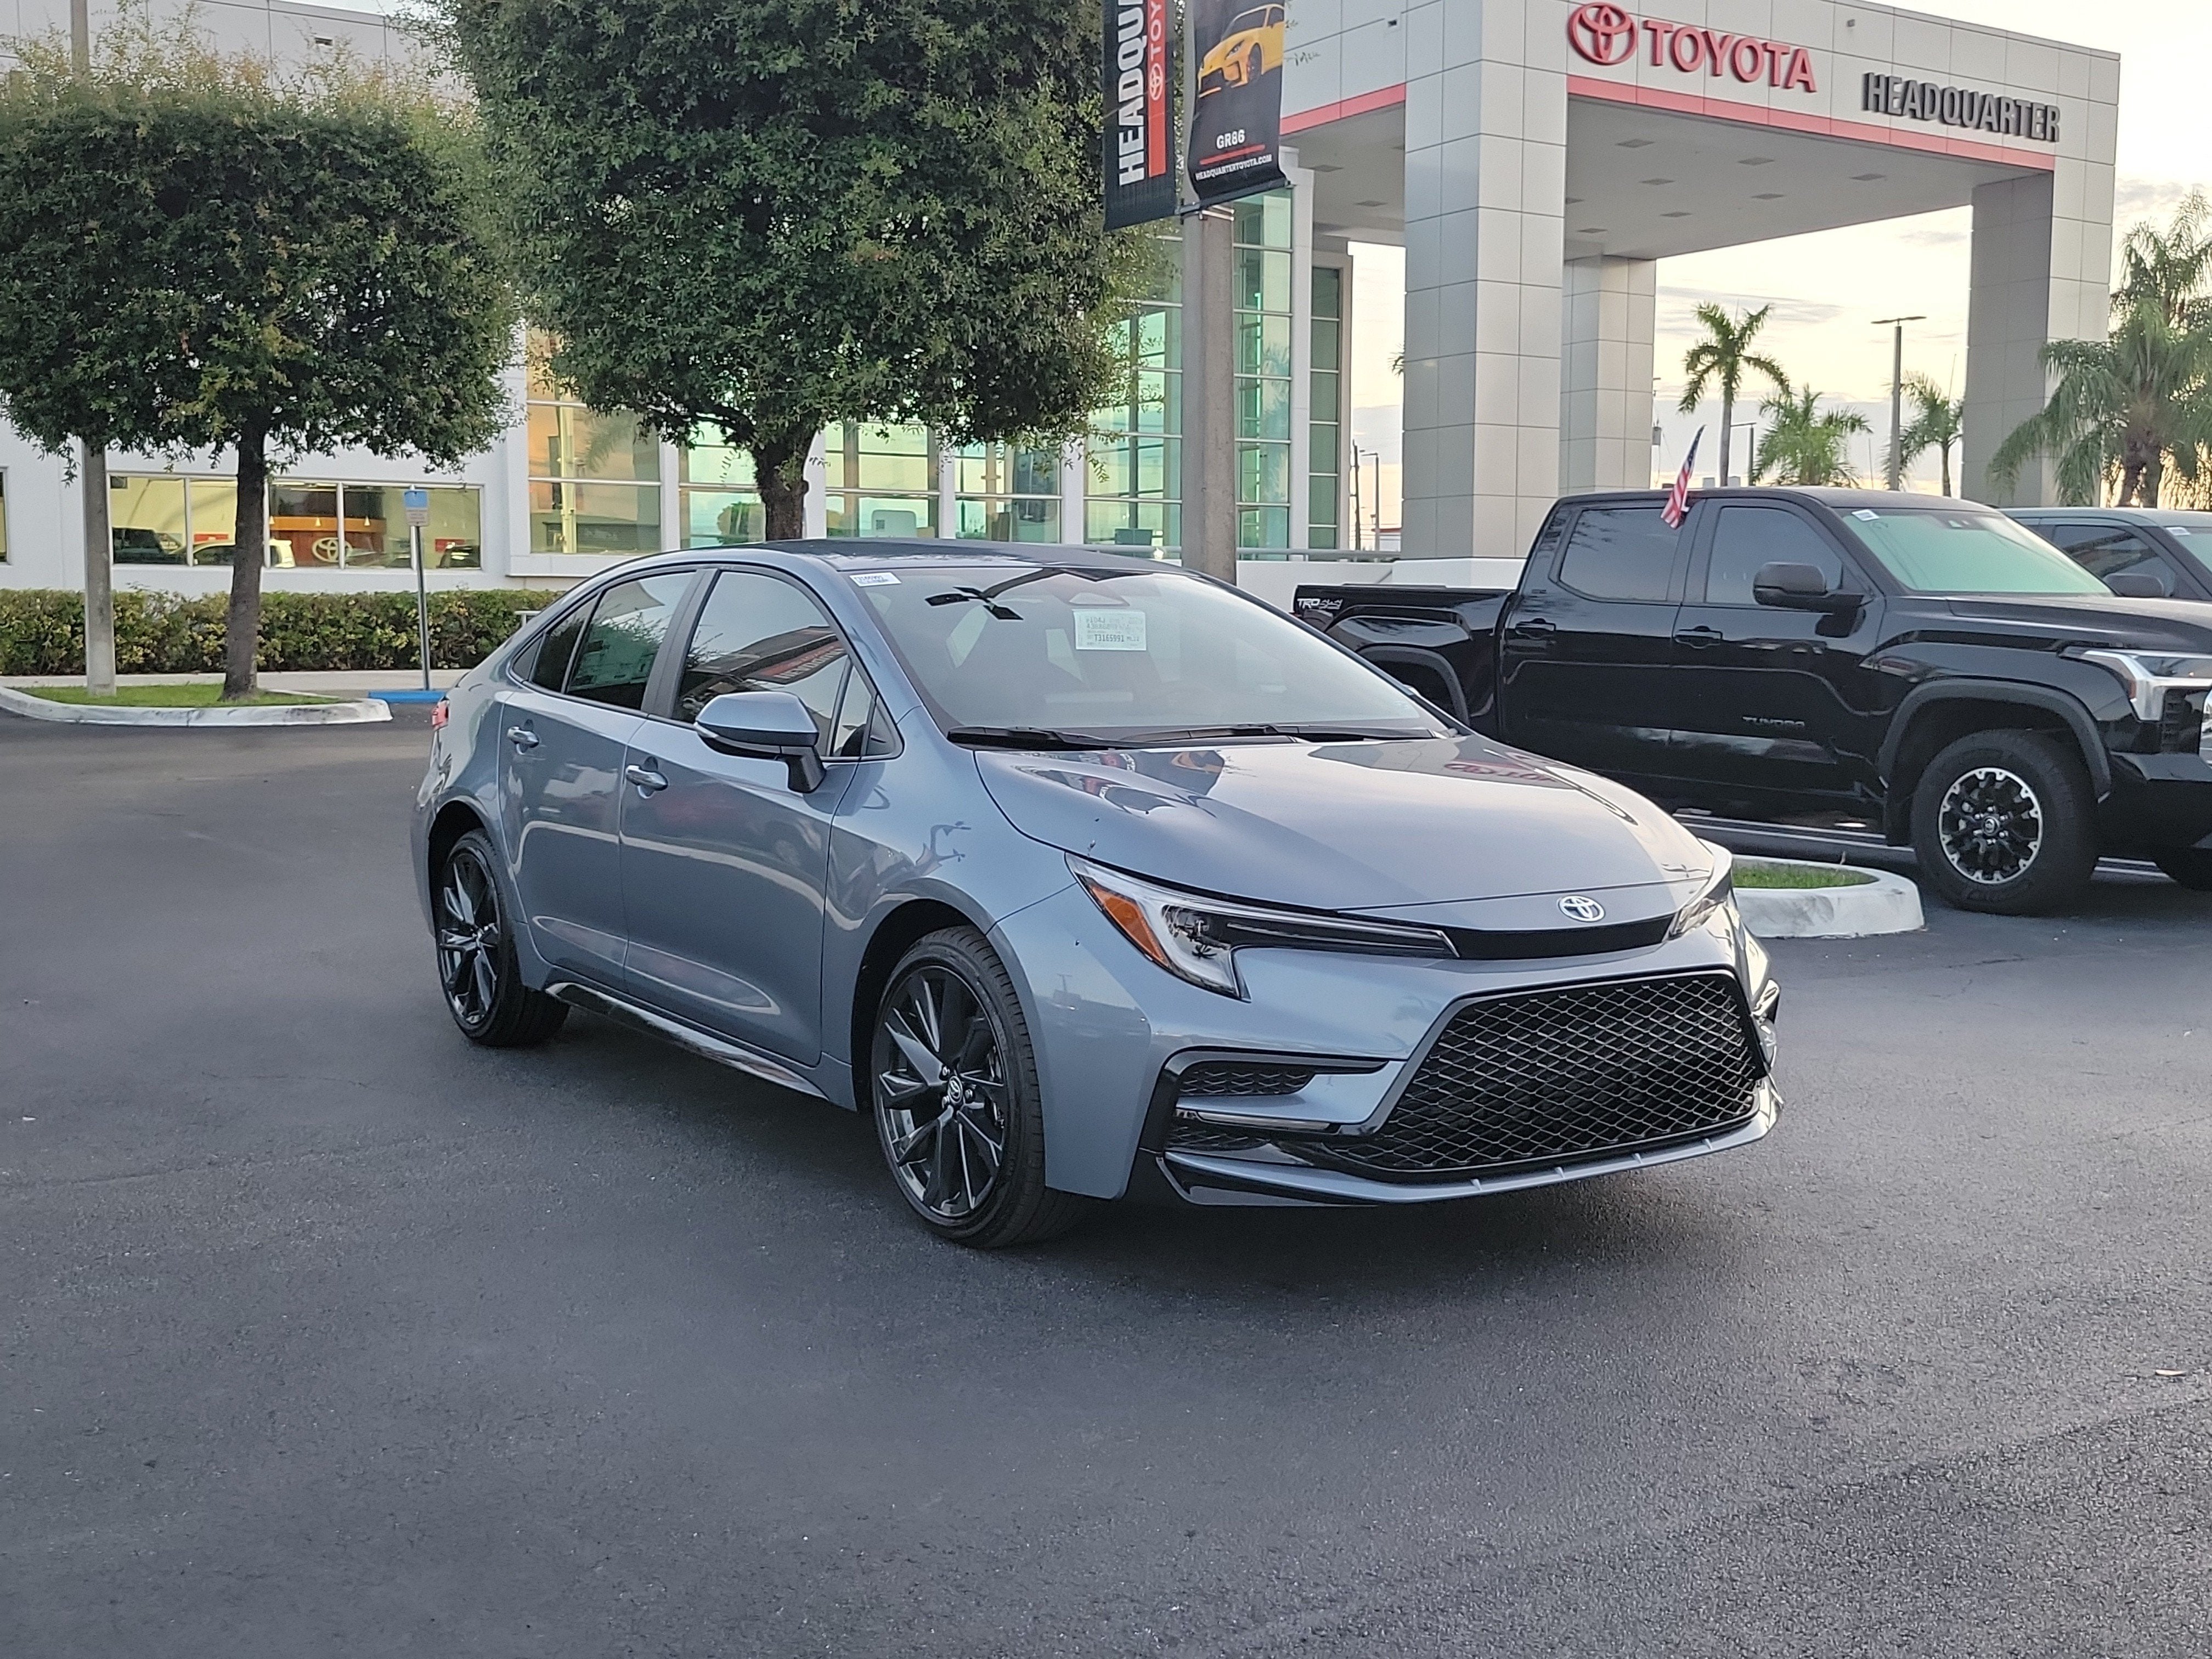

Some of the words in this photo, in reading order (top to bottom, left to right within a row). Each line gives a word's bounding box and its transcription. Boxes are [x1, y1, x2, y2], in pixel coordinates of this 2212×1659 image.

[1644, 20, 1817, 92] TOYOTA
[1118, 0, 1147, 185] HEADQU
[1861, 72, 2061, 142] HEADQUARTER
[1216, 129, 1245, 149] GR86
[1195, 154, 1273, 181] HEADQUARTERTOYOTA.COM
[1297, 598, 1321, 610] TRD
